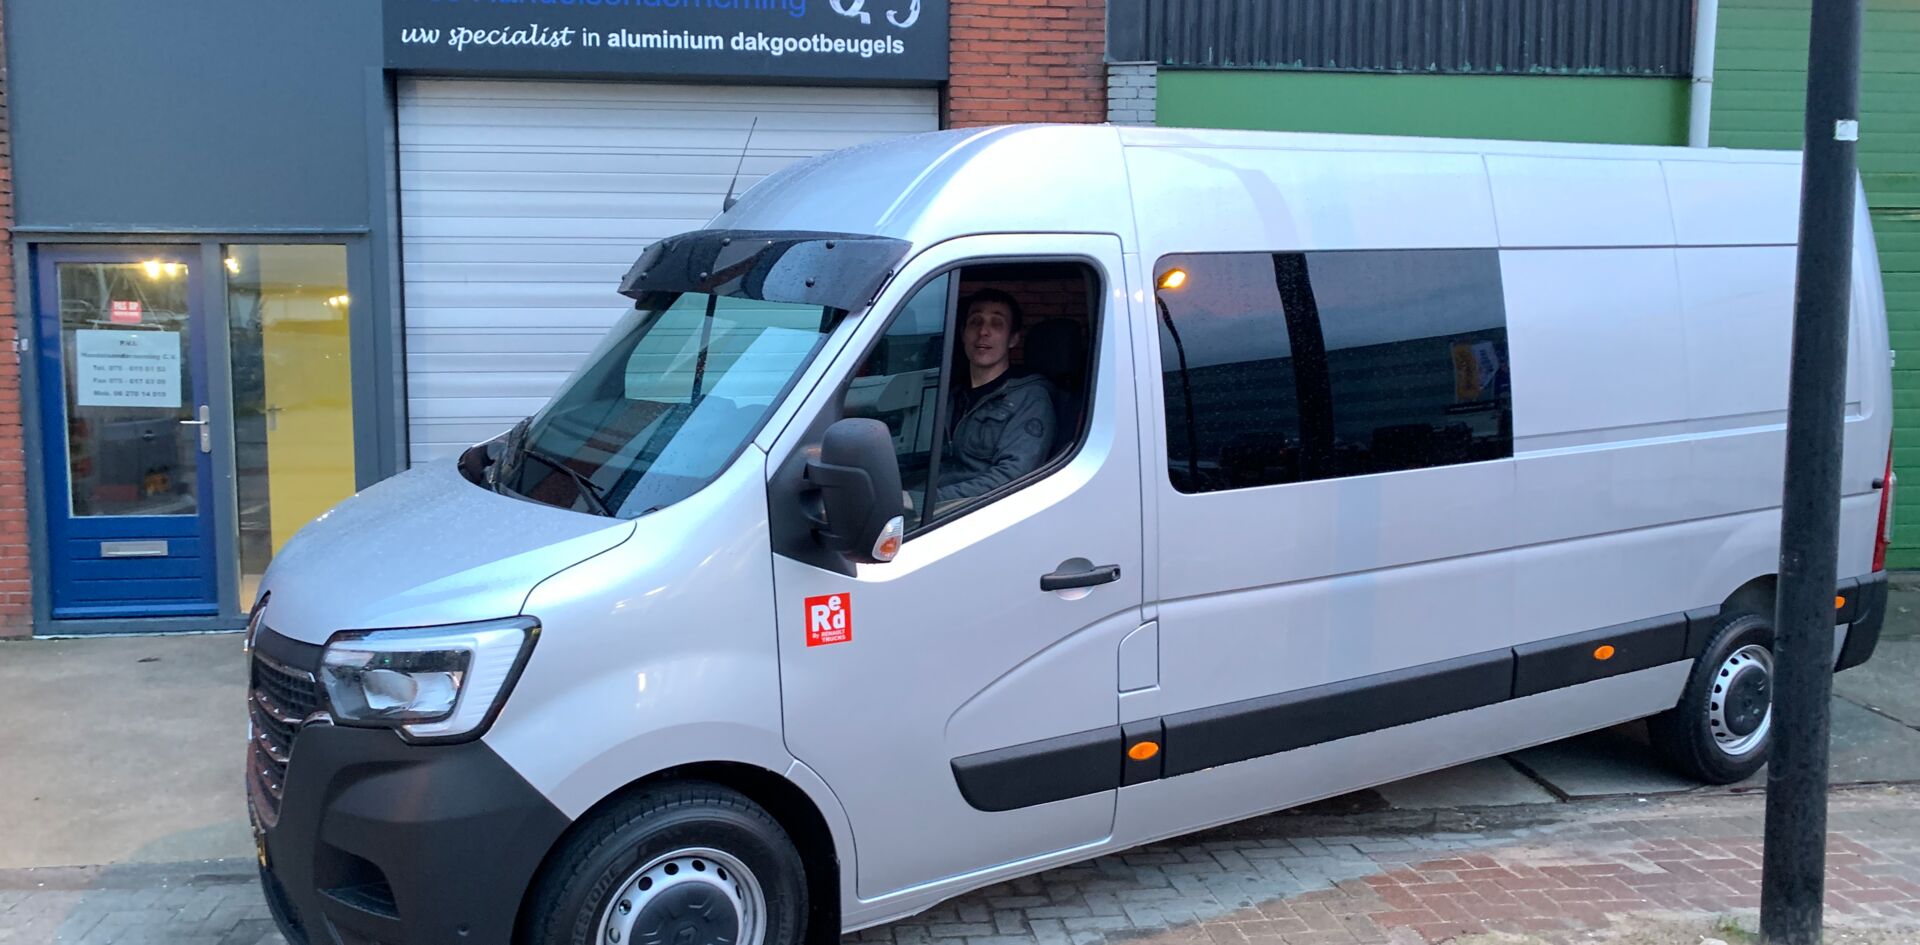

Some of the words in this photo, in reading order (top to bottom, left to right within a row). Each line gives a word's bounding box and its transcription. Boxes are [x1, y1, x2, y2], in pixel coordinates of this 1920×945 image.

[401, 27, 440, 44] uw
[448, 23, 576, 52] specialist
[582, 28, 600, 47] in
[607, 29, 724, 50] aluminium
[730, 32, 905, 58] dakgootbeugels
[811, 596, 846, 632] Red
